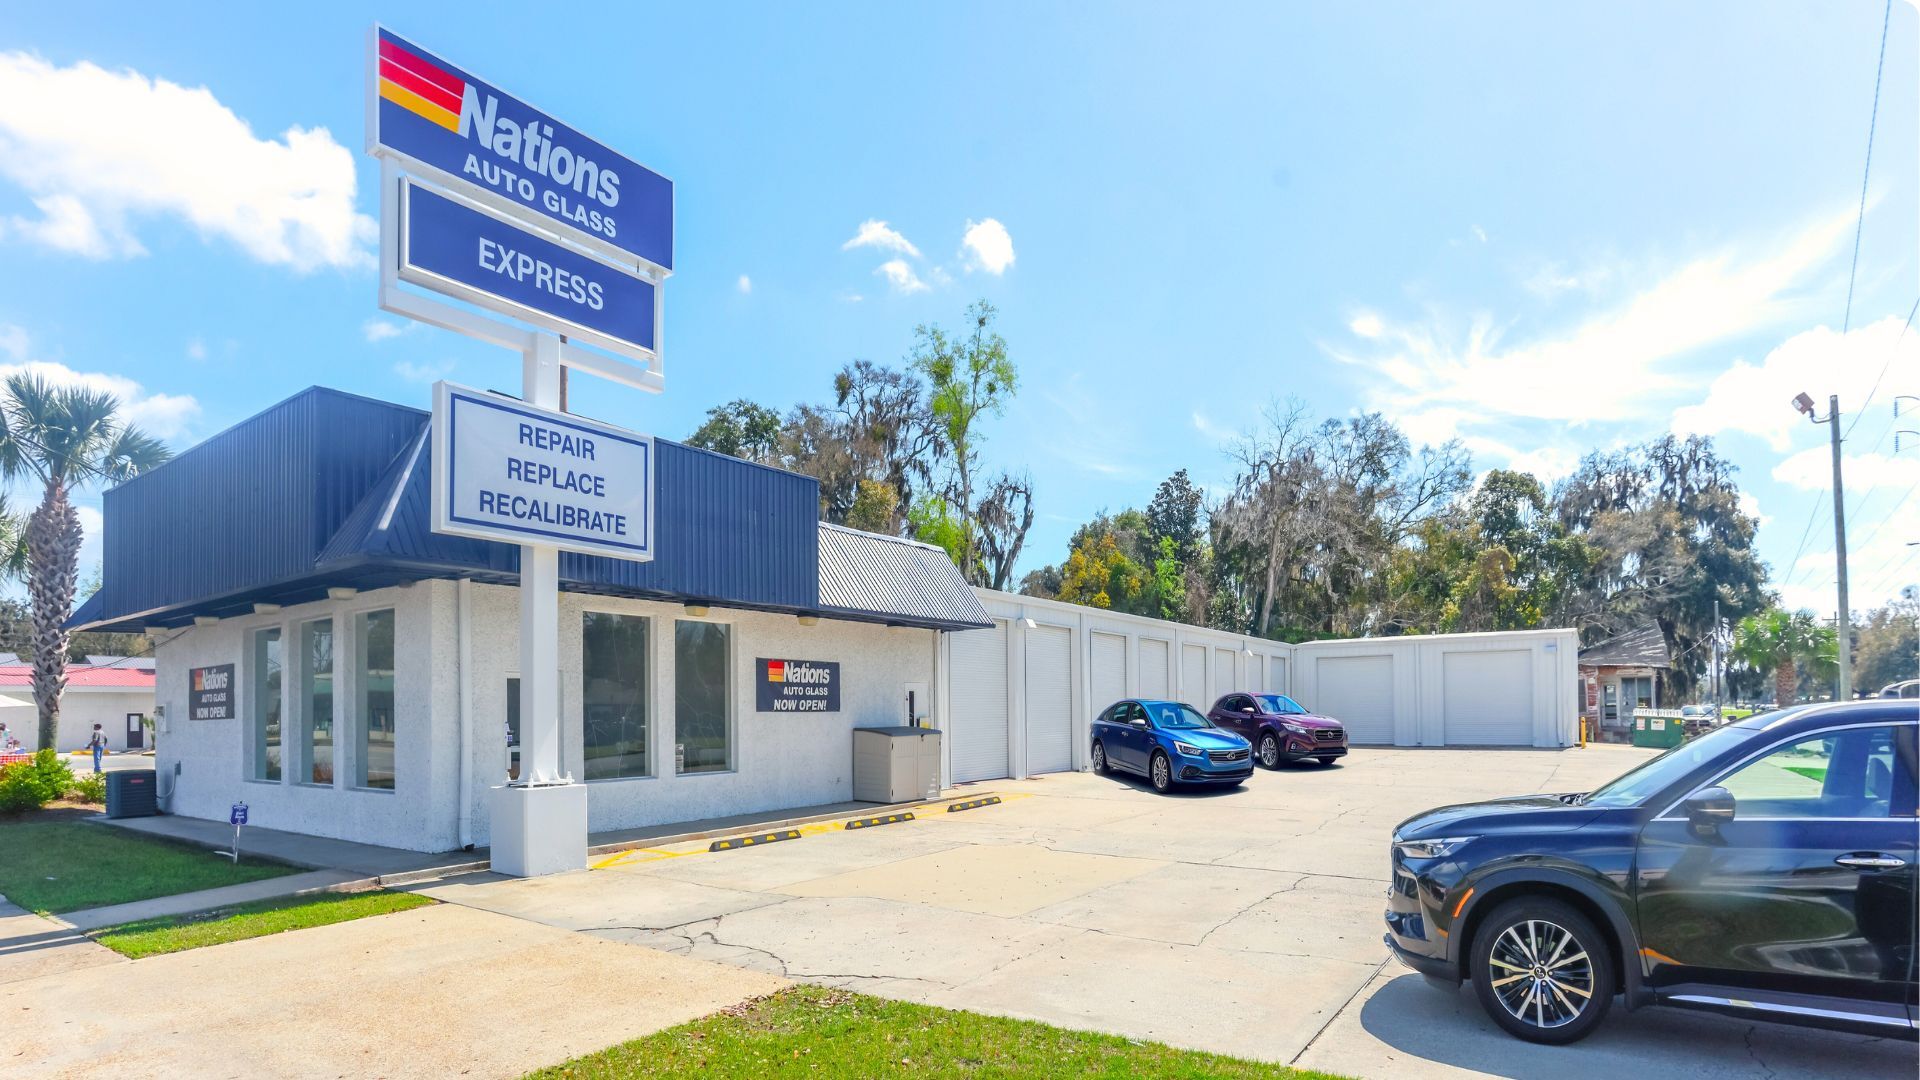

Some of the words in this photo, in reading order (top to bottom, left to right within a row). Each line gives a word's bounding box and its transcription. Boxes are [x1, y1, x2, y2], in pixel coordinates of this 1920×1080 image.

[457, 81, 620, 208] Nations
[464, 153, 535, 202] AUTO
[543, 190, 617, 238] GLASS
[479, 236, 604, 311] EXPRESS
[519, 422, 595, 462] REPAIR
[507, 457, 605, 498] REPLACE
[479, 489, 627, 536] RECALIBRATE
[202, 668, 228, 690] Nations
[783, 661, 830, 684] Nations
[213, 692, 227, 702] GLASS
[773, 699, 797, 711] NOW
[799, 699, 827, 711] OPEN!
[783, 686, 804, 696] AUTO
[805, 686, 828, 696] GLASS
[196, 707, 209, 719] NOW
[210, 706, 226, 718] OPEN!
